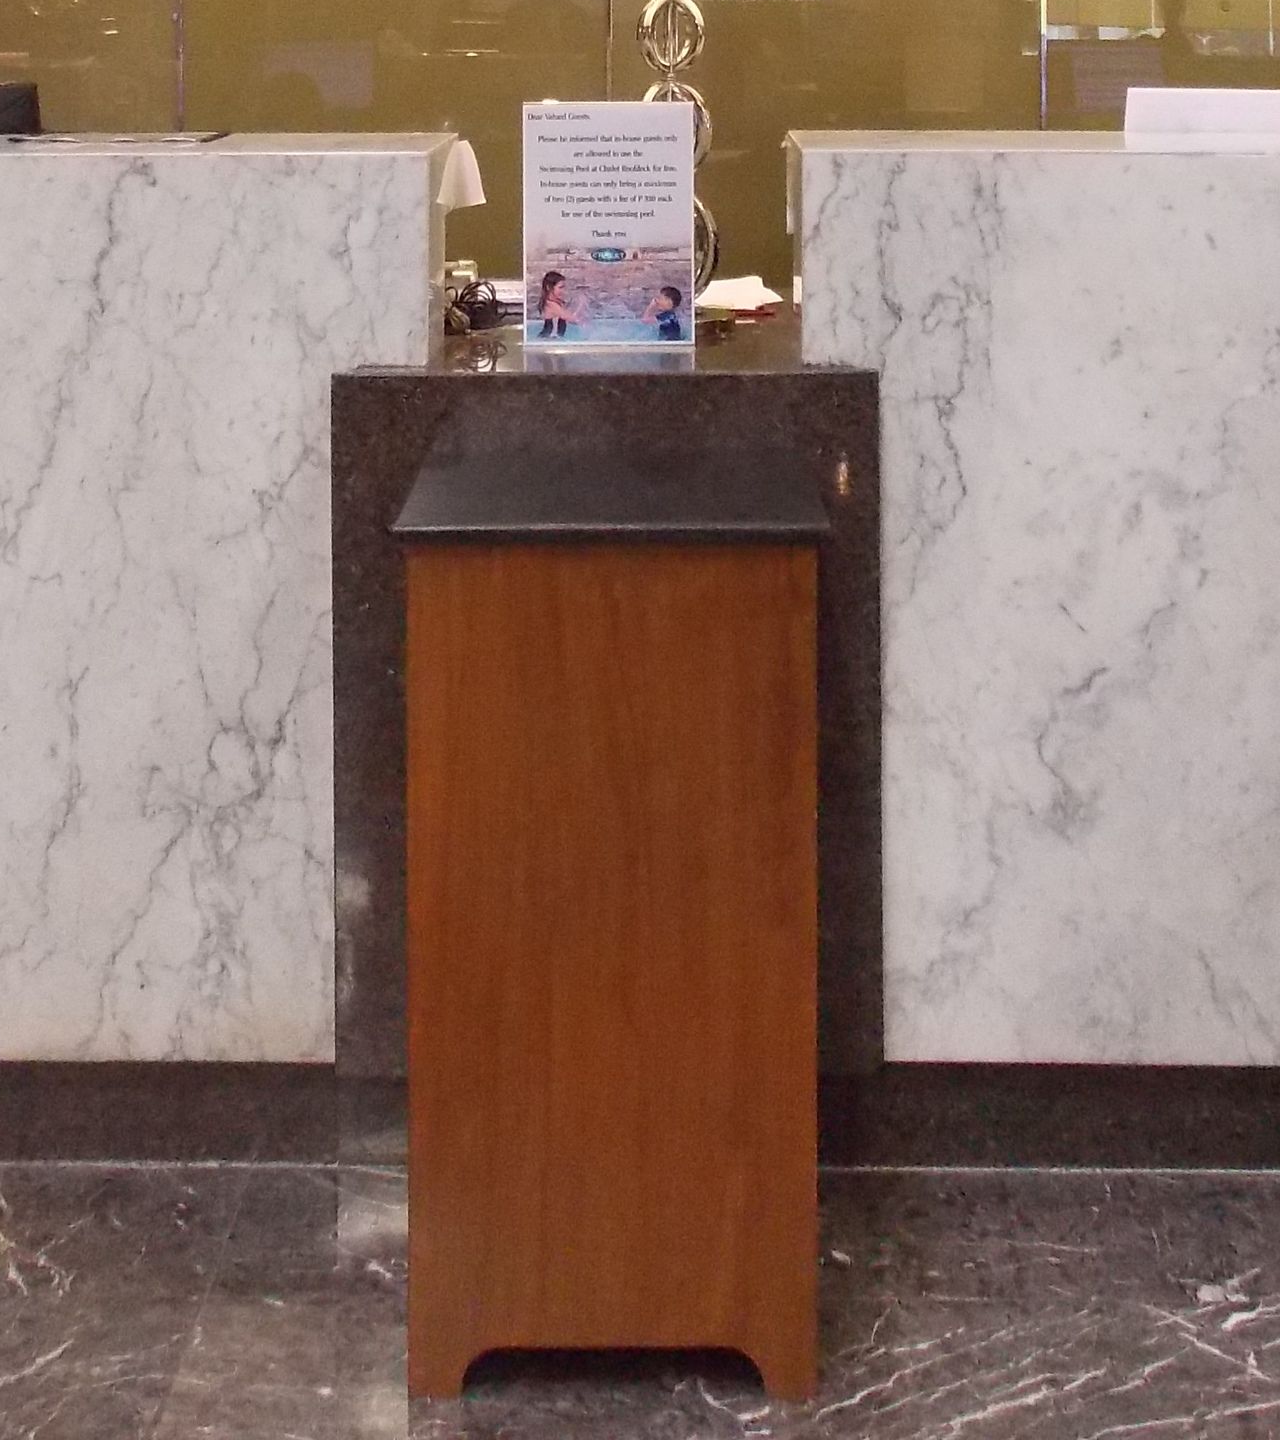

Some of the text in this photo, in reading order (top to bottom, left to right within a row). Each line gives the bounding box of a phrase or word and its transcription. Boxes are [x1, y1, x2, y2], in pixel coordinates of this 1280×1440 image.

[537, 135, 558, 143] Please
[559, 135, 568, 143] be
[570, 135, 599, 143] informed
[600, 135, 613, 143] that
[643, 135, 663, 144] guests
[664, 134, 678, 144] only
[585, 150, 611, 158] allowed
[633, 150, 643, 158] the
[539, 165, 574, 174] Swimming
[576, 165, 590, 173] Pool
[569, 181, 589, 189] guests
[603, 180, 617, 189] only
[576, 195, 596, 204] guests
